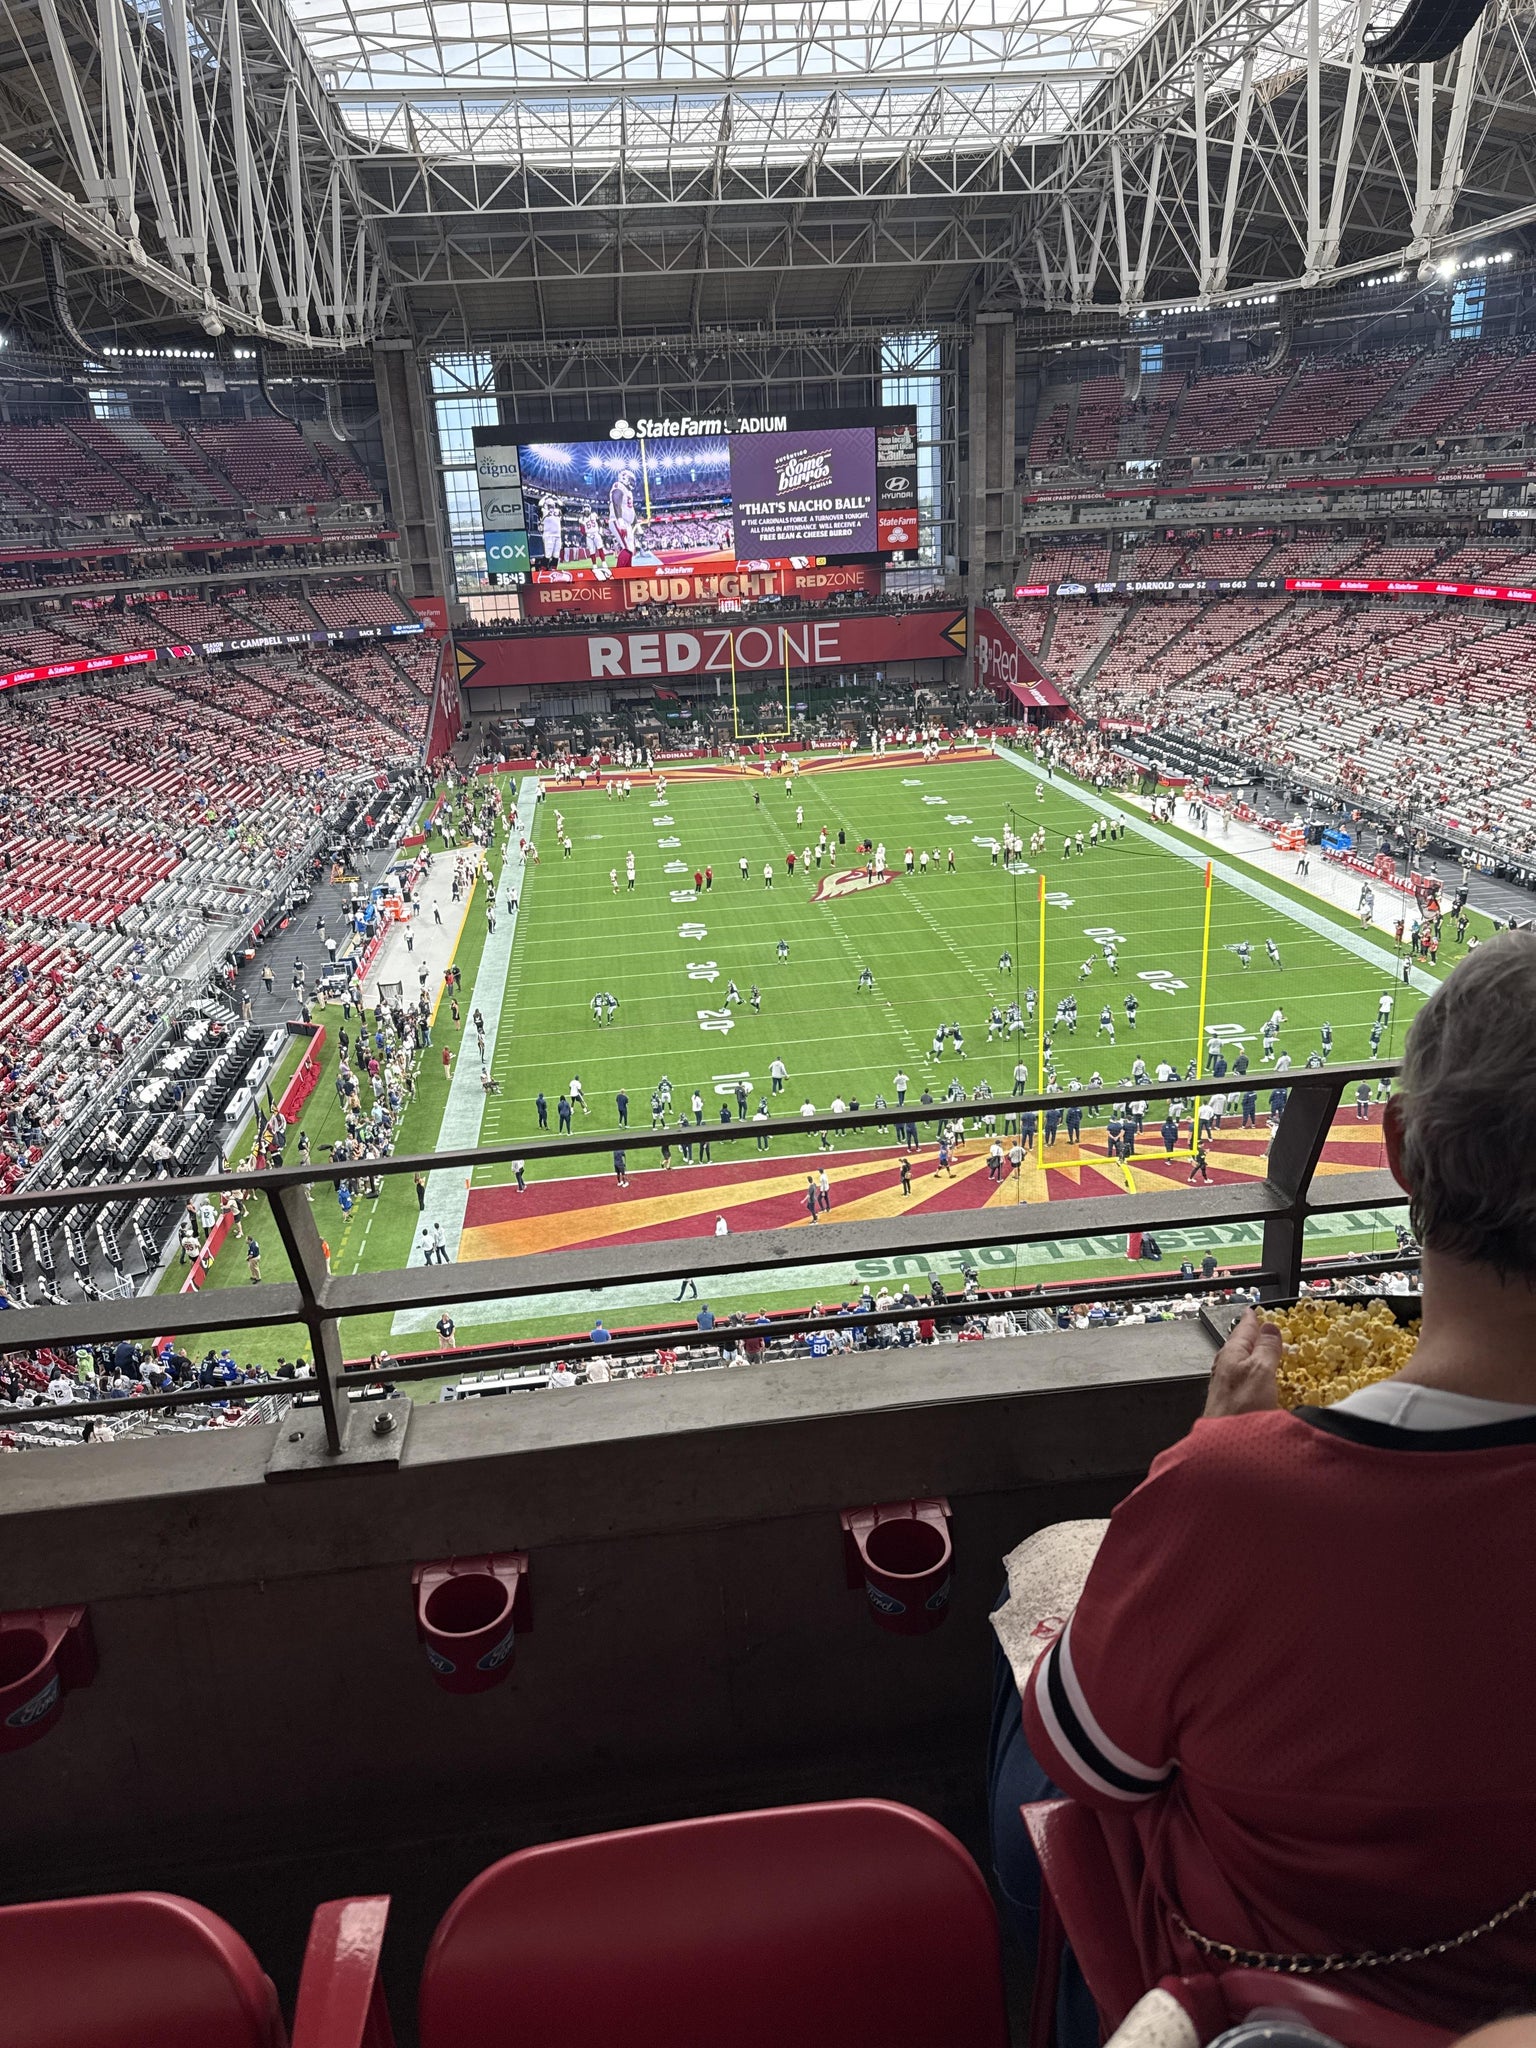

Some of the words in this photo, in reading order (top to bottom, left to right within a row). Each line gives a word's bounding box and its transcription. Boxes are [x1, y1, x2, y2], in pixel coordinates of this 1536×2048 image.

[724, 416, 787, 433] SADIUM
[785, 456, 824, 477] Some
[779, 465, 830, 491] burros
[882, 492, 913, 500] HYUNDAI
[1053, 494, 1077, 502] (PADDY)
[490, 503, 522, 514] ACP
[788, 499, 833, 513] NACHO
[747, 518, 758, 526] THE
[758, 517, 790, 525] CARDINALS
[783, 524, 817, 532] ATTENDANCE
[819, 522, 833, 530] WILL
[834, 521, 856, 529] RECEIVE
[341, 534, 378, 542] CONZELMAN
[759, 533, 776, 541] FREE
[777, 532, 795, 540] BEAN
[803, 530, 828, 539] CHEESE
[829, 529, 853, 537] BURRO
[796, 572, 865, 588] REDZONE
[1135, 582, 1174, 590] DARNOLD
[539, 587, 612, 603] REDZONE
[629, 578, 691, 603] BUD
[240, 637, 282, 648] CAMPBELL
[588, 622, 841, 677] REDZONE
[653, 752, 693, 760] CARDINALS
[669, 889, 697, 903] 50
[677, 922, 708, 938] 40
[1083, 927, 1127, 945] 30
[686, 961, 720, 980] 30
[1136, 970, 1189, 990] 20
[696, 1009, 735, 1031] 20
[1204, 1023, 1258, 1043] 10
[711, 1071, 754, 1095] 10
[947, 1246, 1017, 1270] OF
[854, 1255, 931, 1278] US
[813, 1344, 827, 1354] 80
